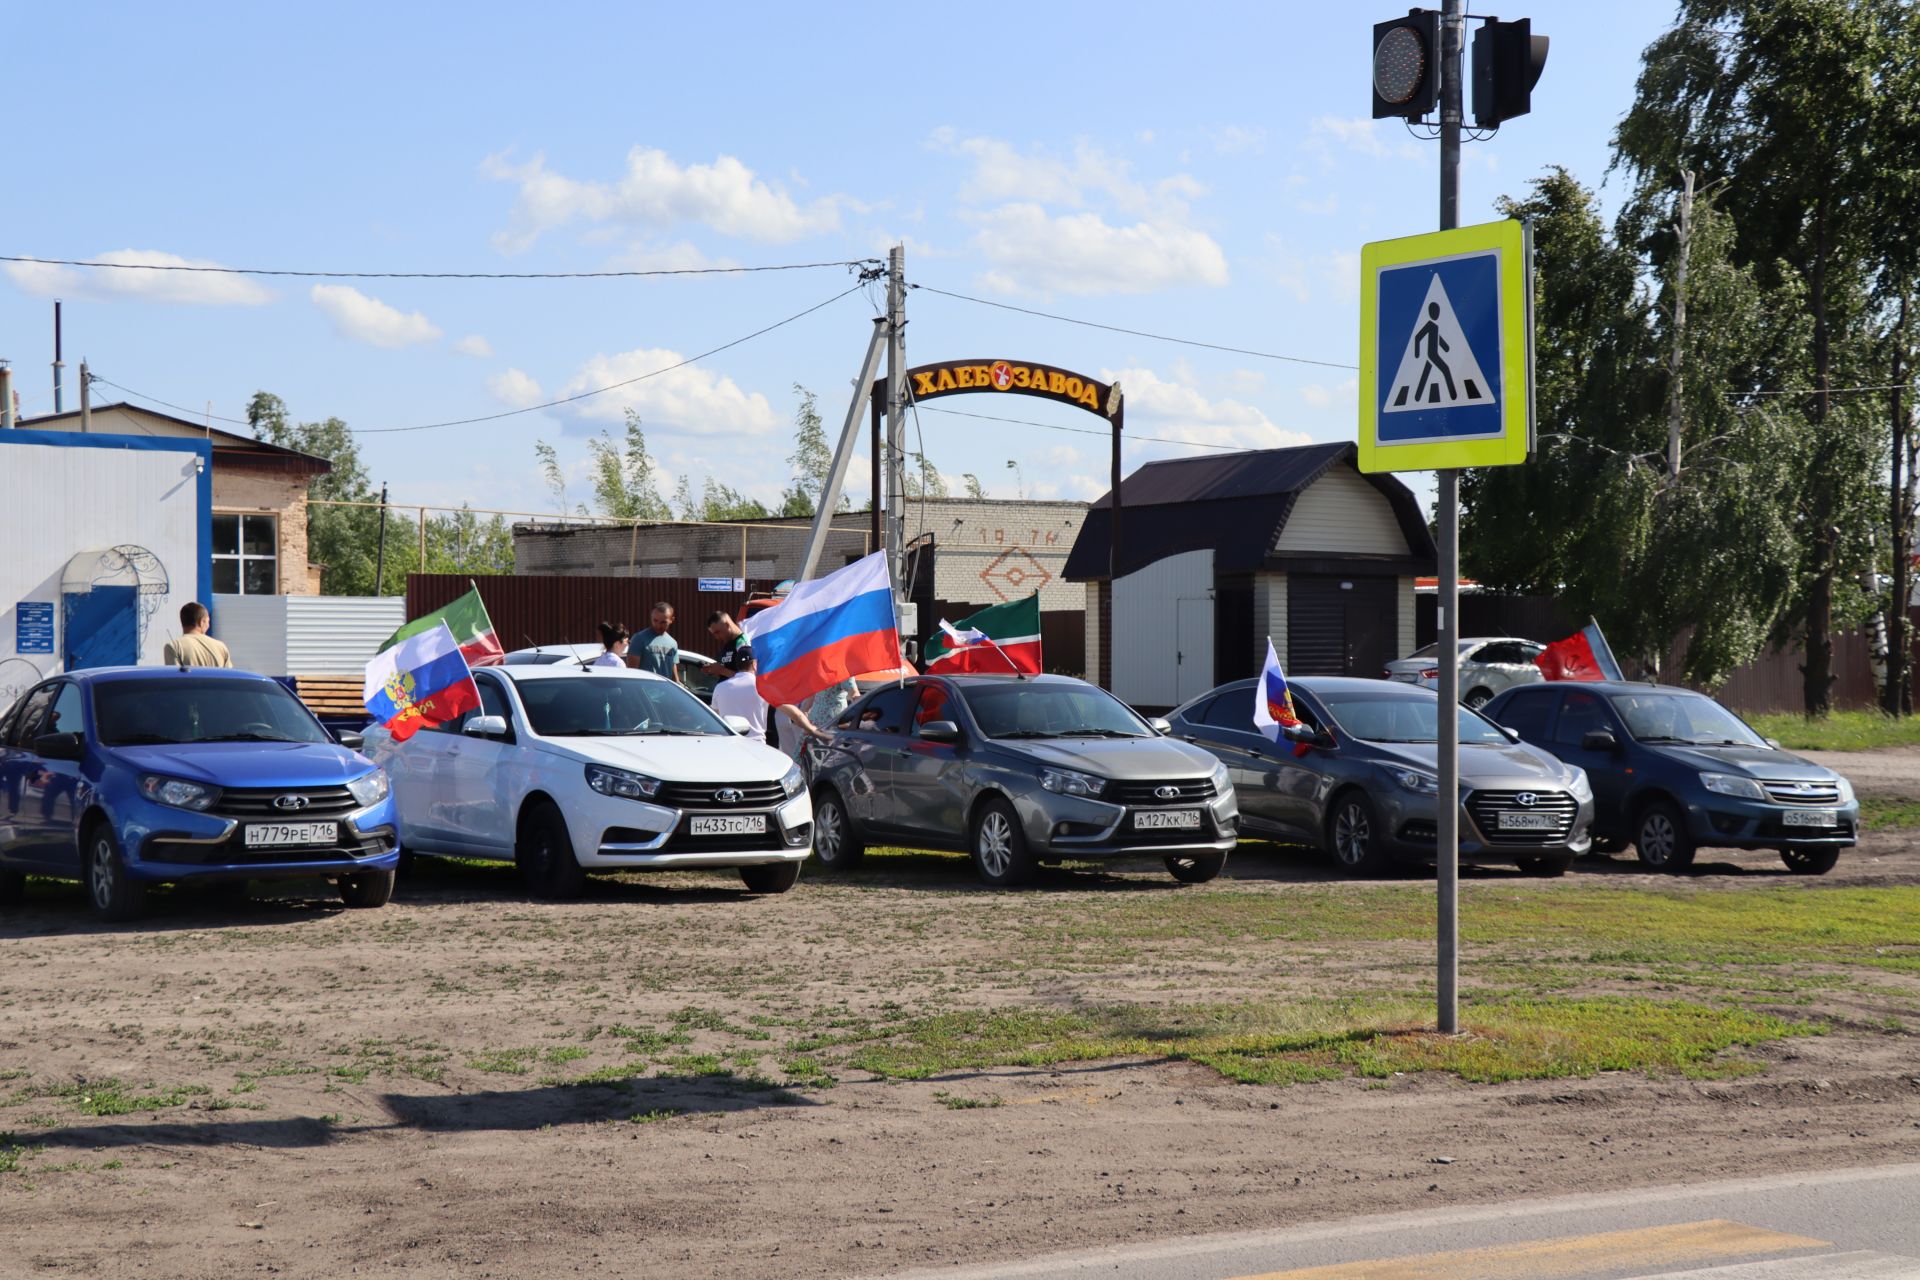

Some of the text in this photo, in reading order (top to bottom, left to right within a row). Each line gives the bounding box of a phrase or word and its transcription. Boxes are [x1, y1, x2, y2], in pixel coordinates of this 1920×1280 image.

[694, 817, 762, 833] Н433ТС 716
[1138, 813, 1181, 827] А127КК
[250, 824, 333, 842] Н779РЕ 716
